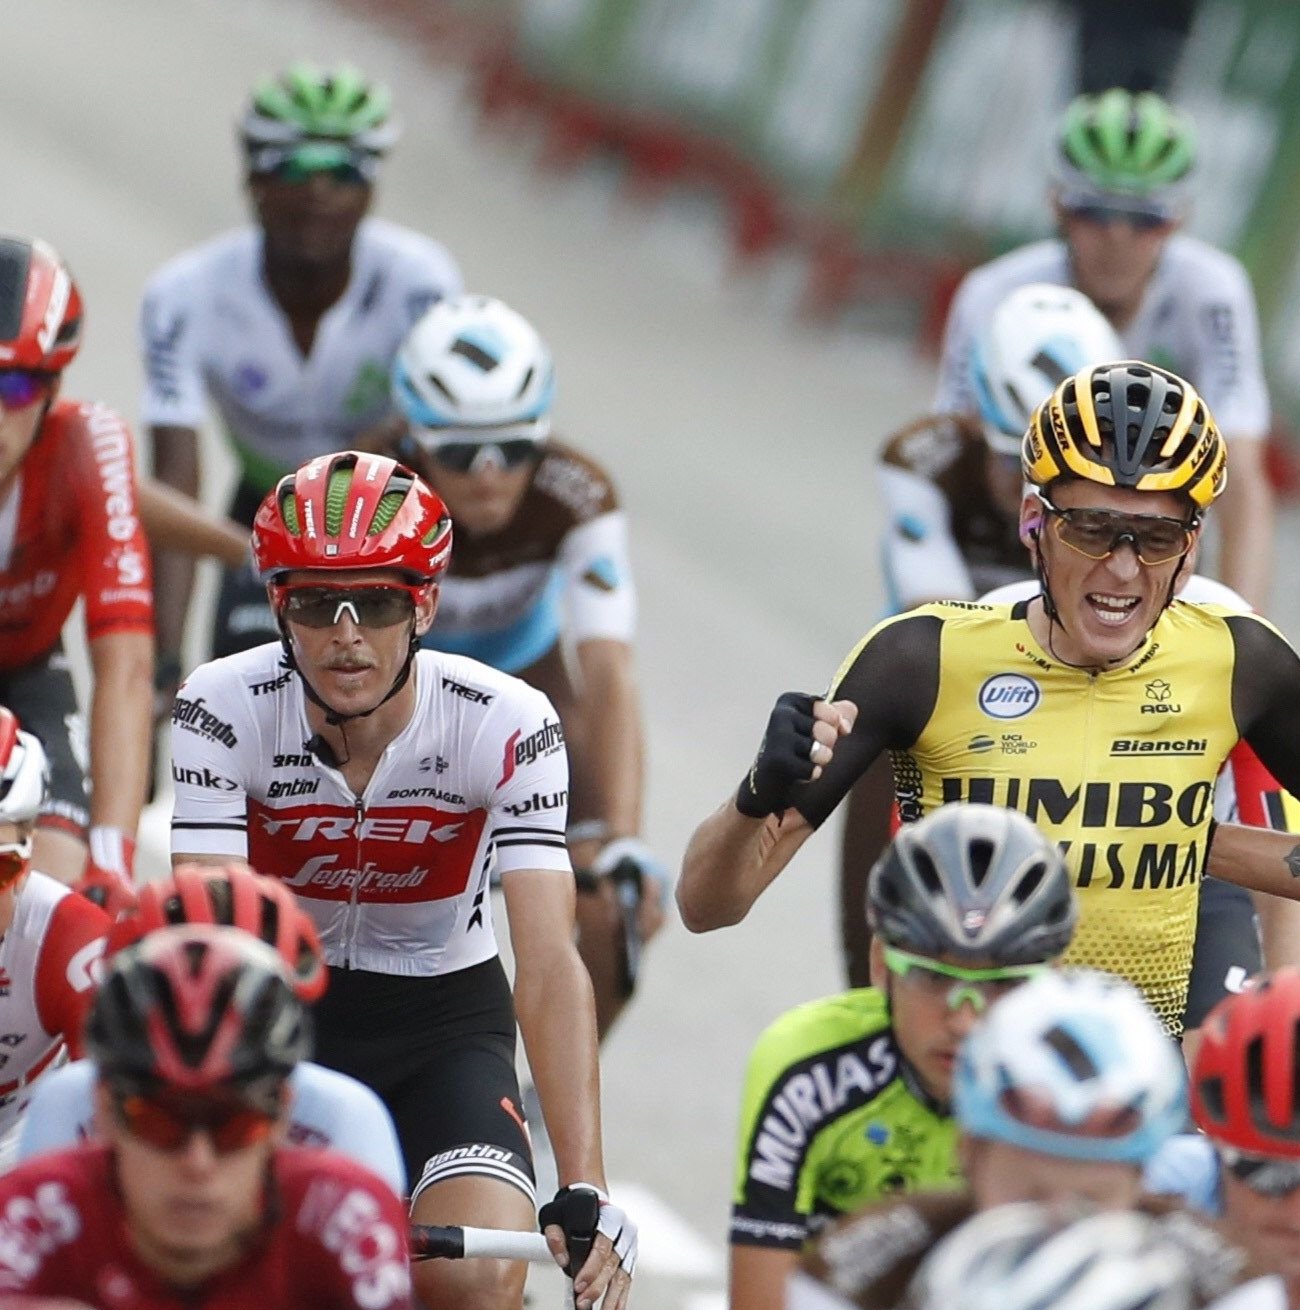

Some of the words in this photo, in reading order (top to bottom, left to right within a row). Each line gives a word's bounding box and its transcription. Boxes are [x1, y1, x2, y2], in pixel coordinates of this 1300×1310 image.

[1051, 406, 1070, 451] LAZER
[441, 678, 494, 706] TREK
[984, 686, 1036, 704] Vifit
[1140, 703, 1181, 714] AGU
[1110, 739, 1207, 753] Bianchi
[386, 787, 466, 805] BONTRAGER
[258, 813, 465, 844] TREK
[750, 1037, 896, 1191] MURIAS
